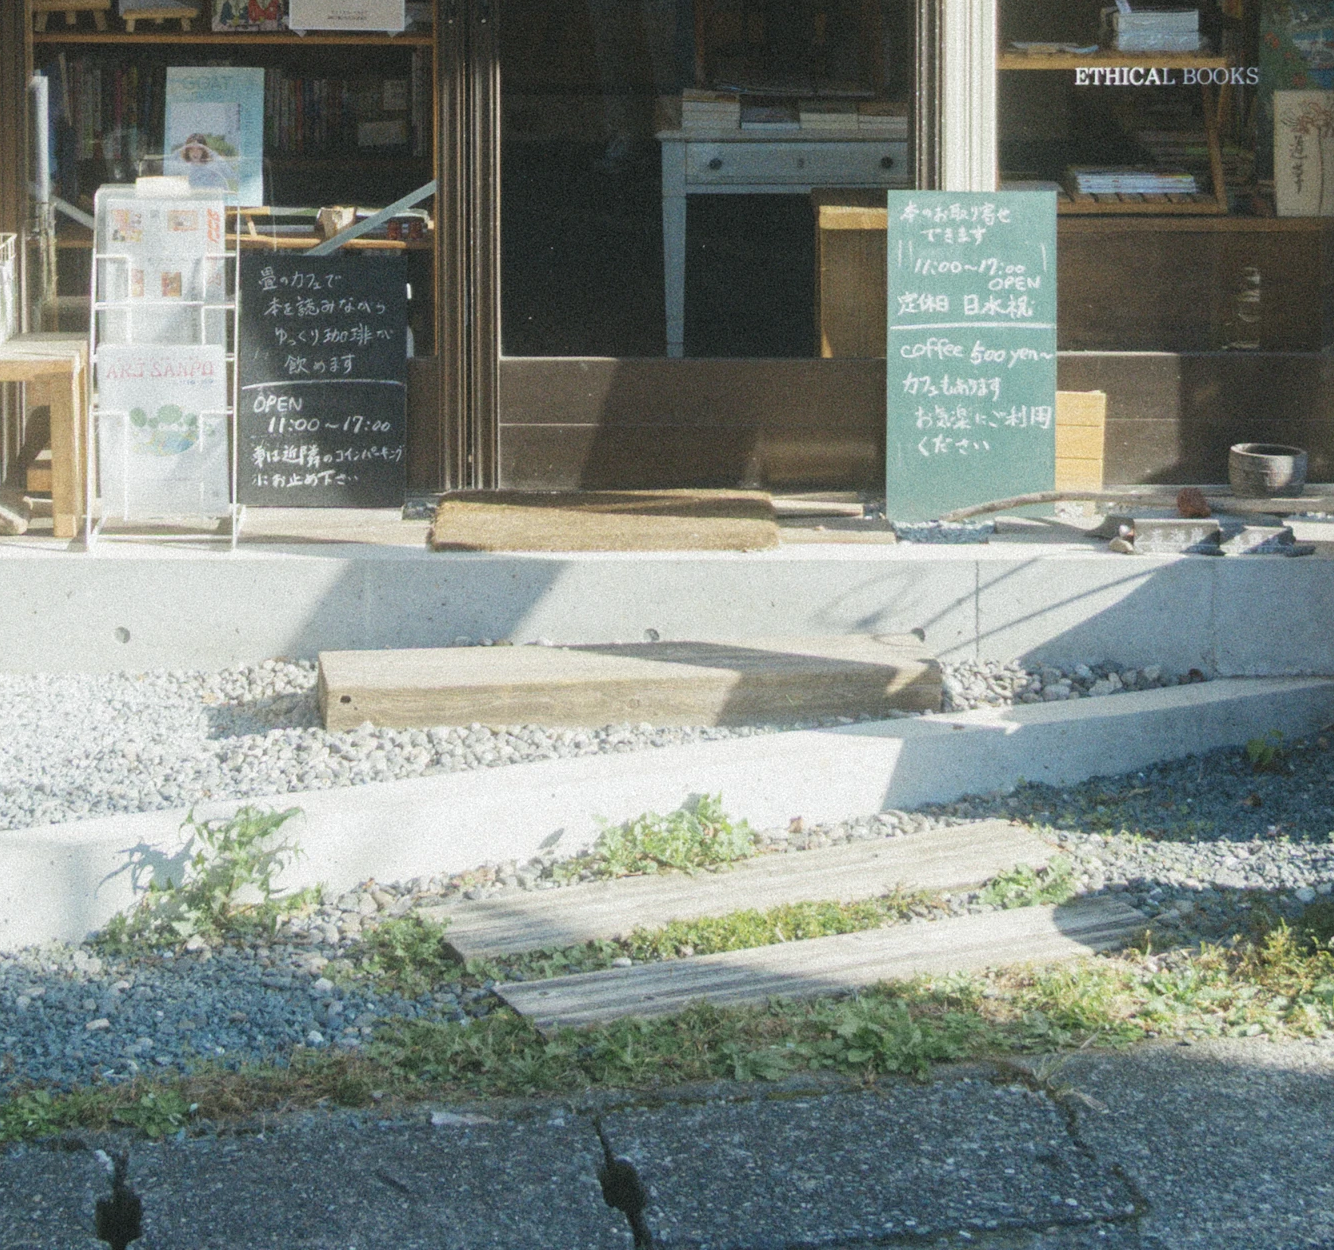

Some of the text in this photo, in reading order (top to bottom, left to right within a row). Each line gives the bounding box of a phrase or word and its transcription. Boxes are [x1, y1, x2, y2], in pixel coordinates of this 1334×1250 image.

[1074, 67, 1259, 86] ETHICAL BOOKS
[258, 266, 342, 290] 畳のカフェで
[988, 276, 1041, 291] OPEN
[897, 291, 949, 316] 定休日
[284, 353, 356, 374] 飲めます
[970, 340, 1006, 365] 500
[902, 371, 1002, 402] カフェもあります
[253, 394, 302, 413] OPEN
[915, 404, 1053, 430] お気楽にご利用
[918, 433, 990, 457] ください
